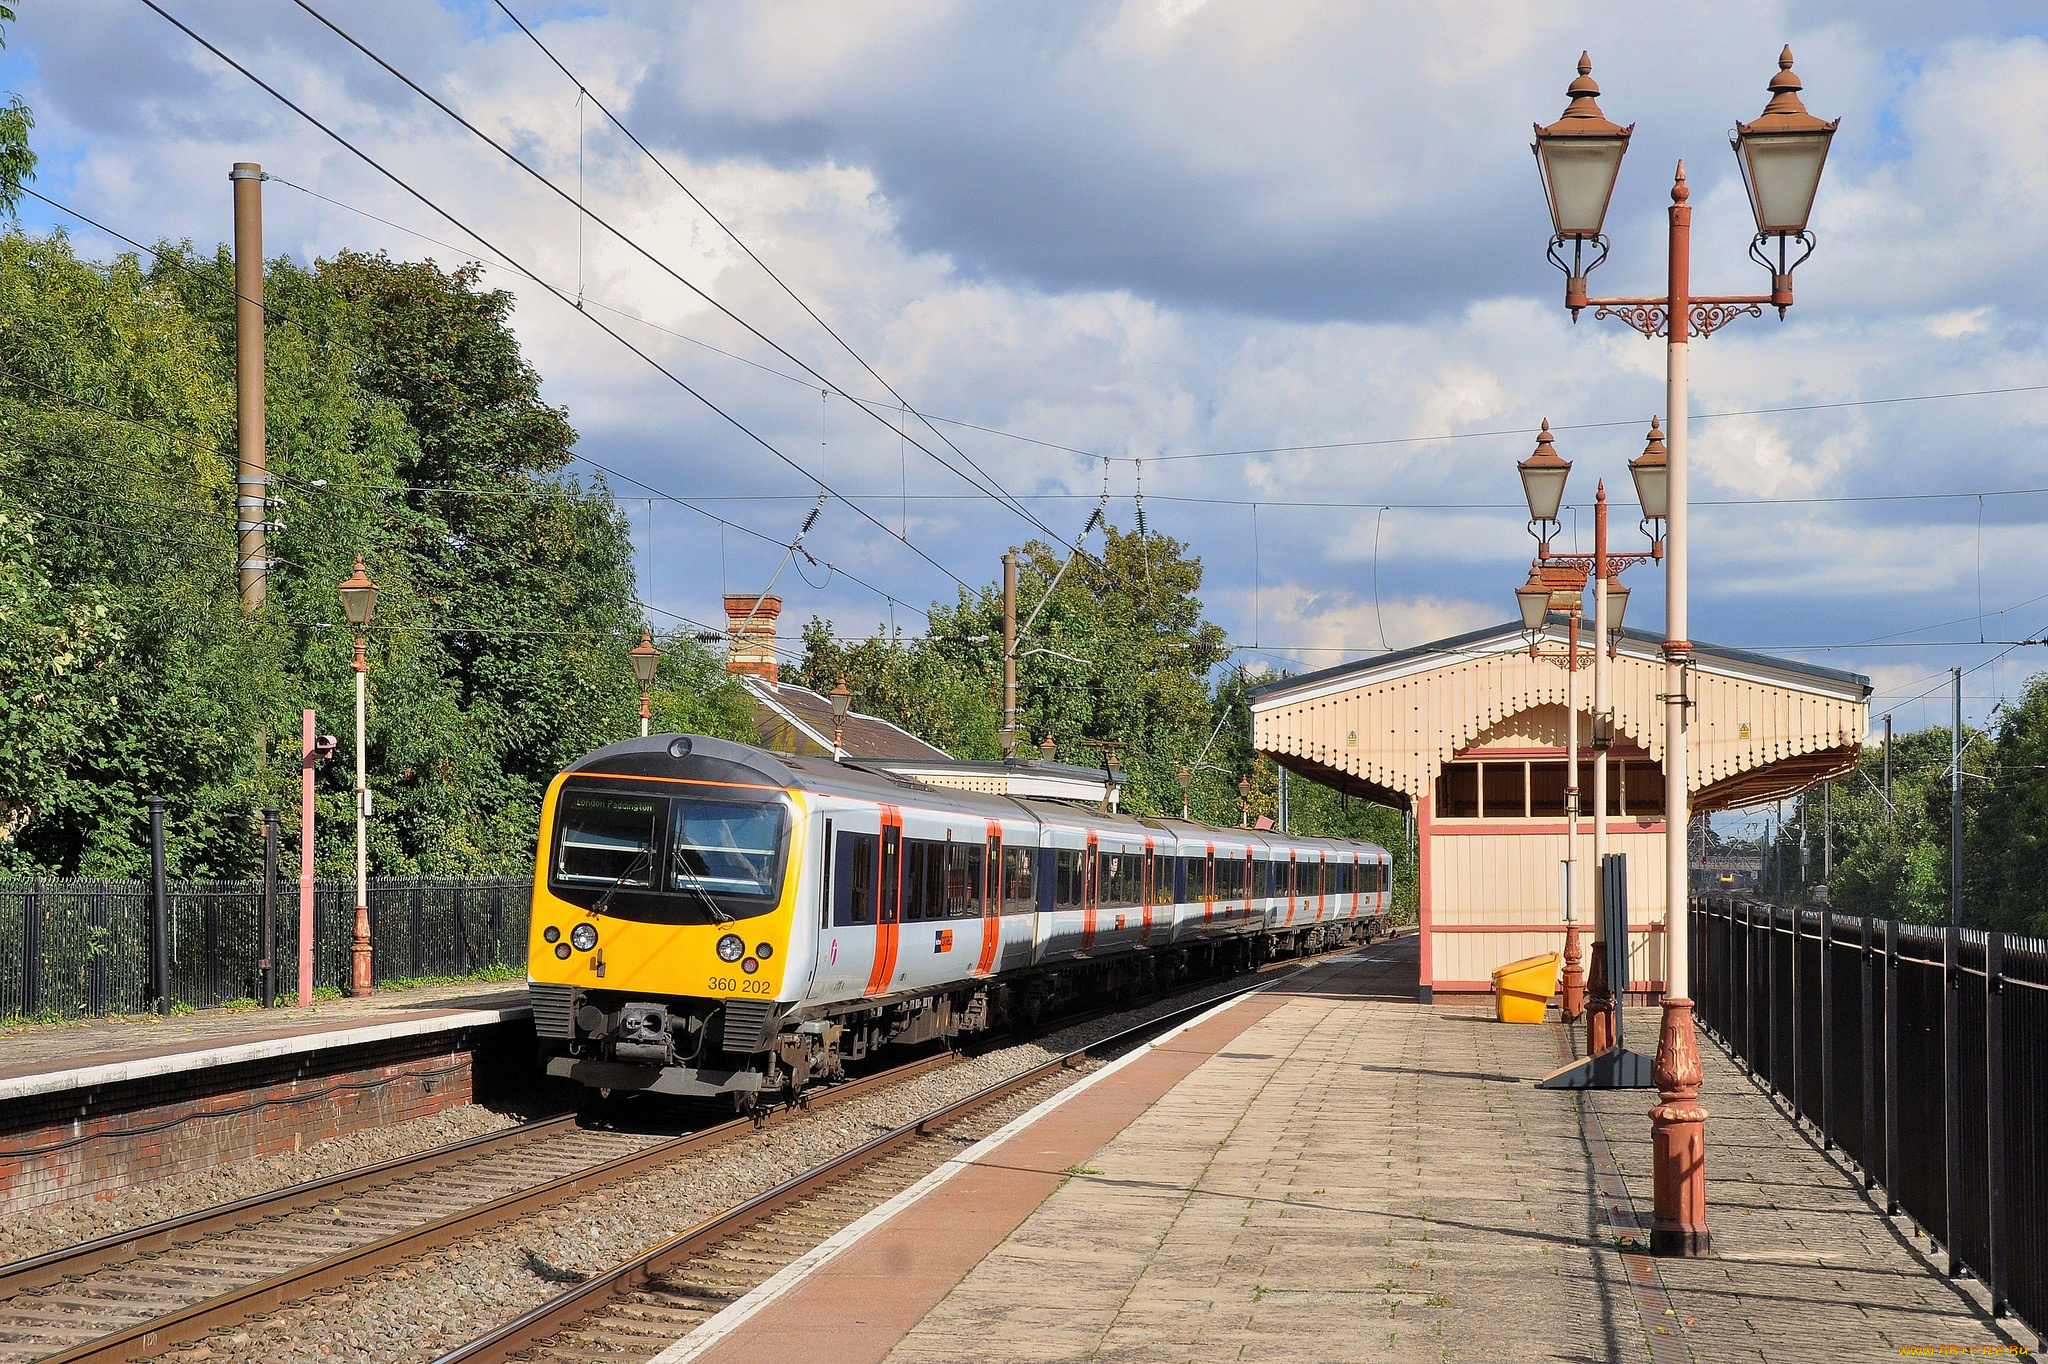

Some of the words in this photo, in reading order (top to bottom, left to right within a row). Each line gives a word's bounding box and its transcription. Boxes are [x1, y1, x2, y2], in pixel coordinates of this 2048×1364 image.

[576, 799, 605, 808] London
[607, 800, 653, 812] Paddington
[708, 976, 737, 992] 360
[742, 979, 771, 995] 202
